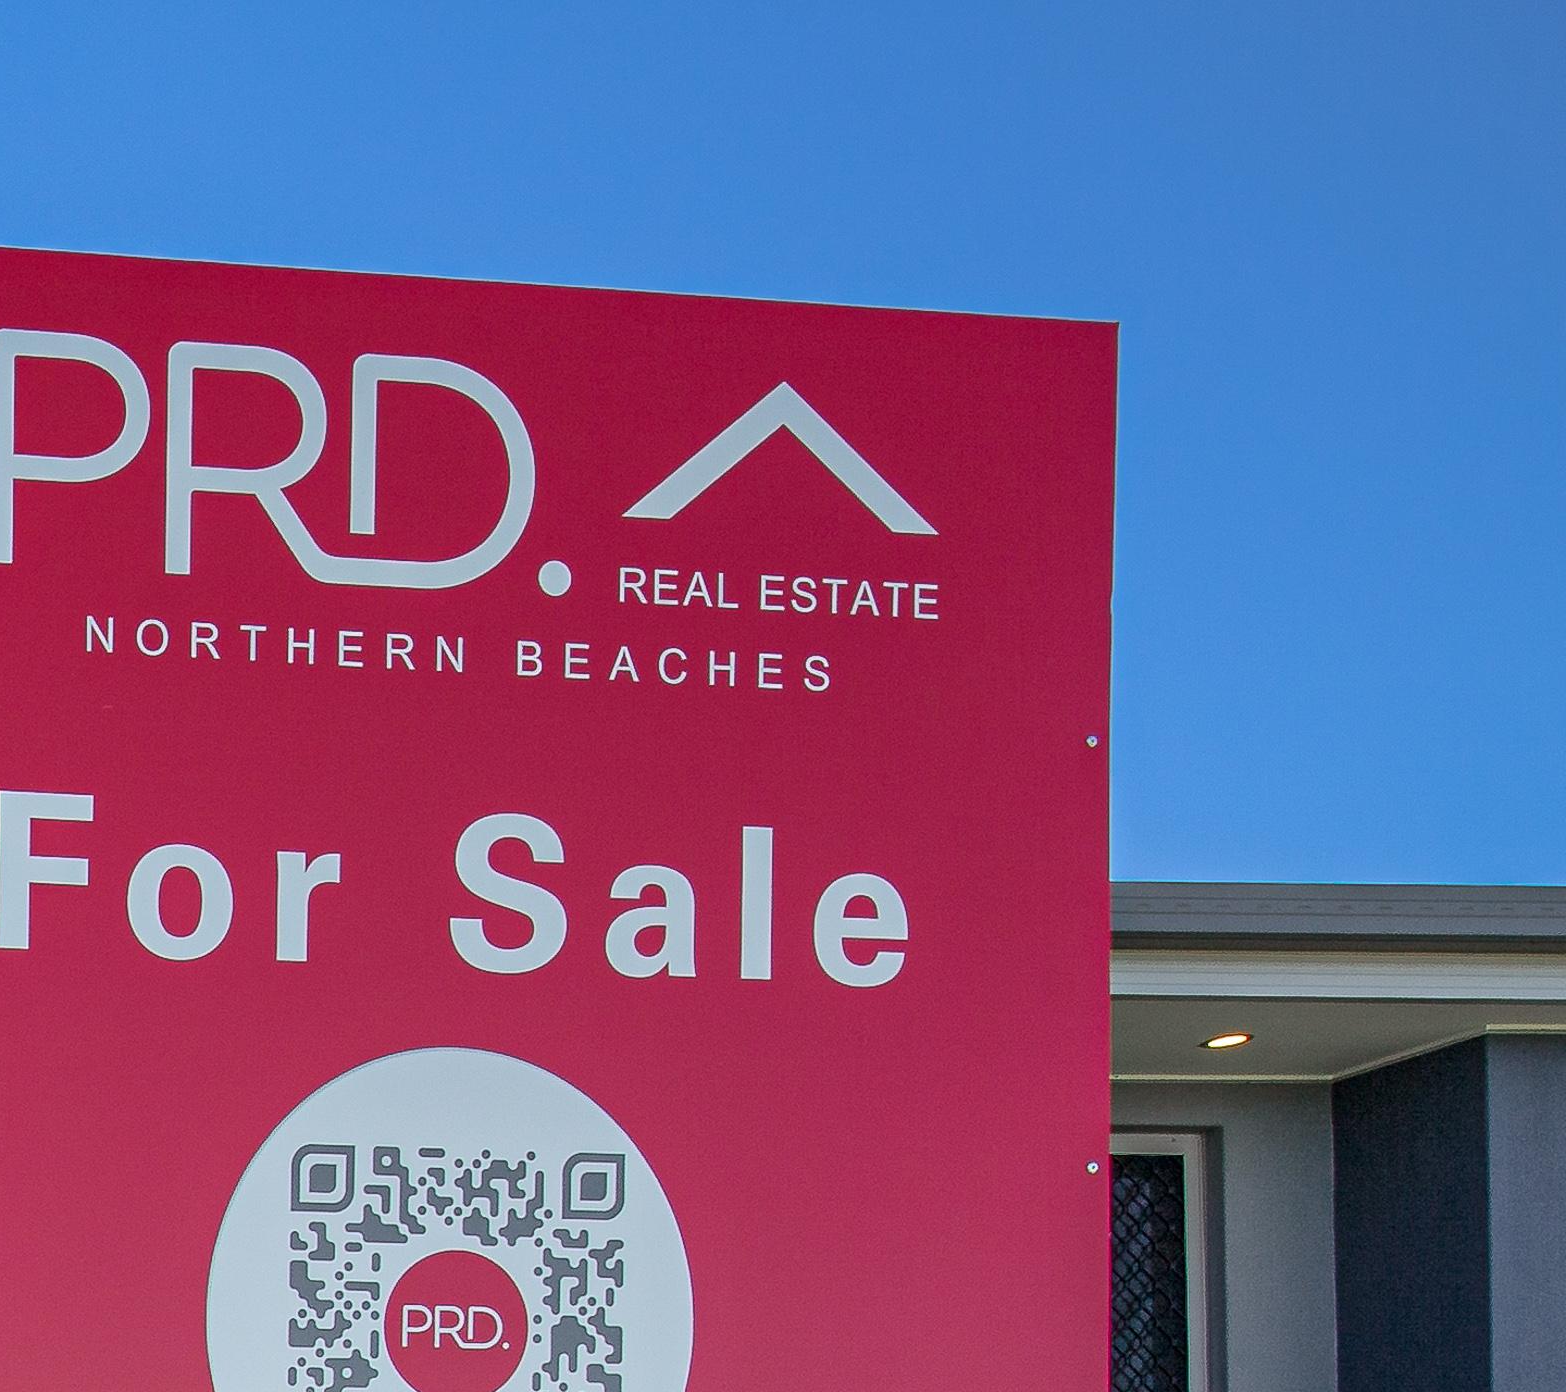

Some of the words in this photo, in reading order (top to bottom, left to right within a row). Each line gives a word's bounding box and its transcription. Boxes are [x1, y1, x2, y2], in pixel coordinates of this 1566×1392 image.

[618, 565, 740, 610] REAL
[758, 573, 940, 621] ESTATE
[85, 614, 465, 674] NORTHERN
[515, 638, 831, 693] BEACHES
[448, 811, 910, 989] Sale
[400, 1303, 511, 1351] PRD.
